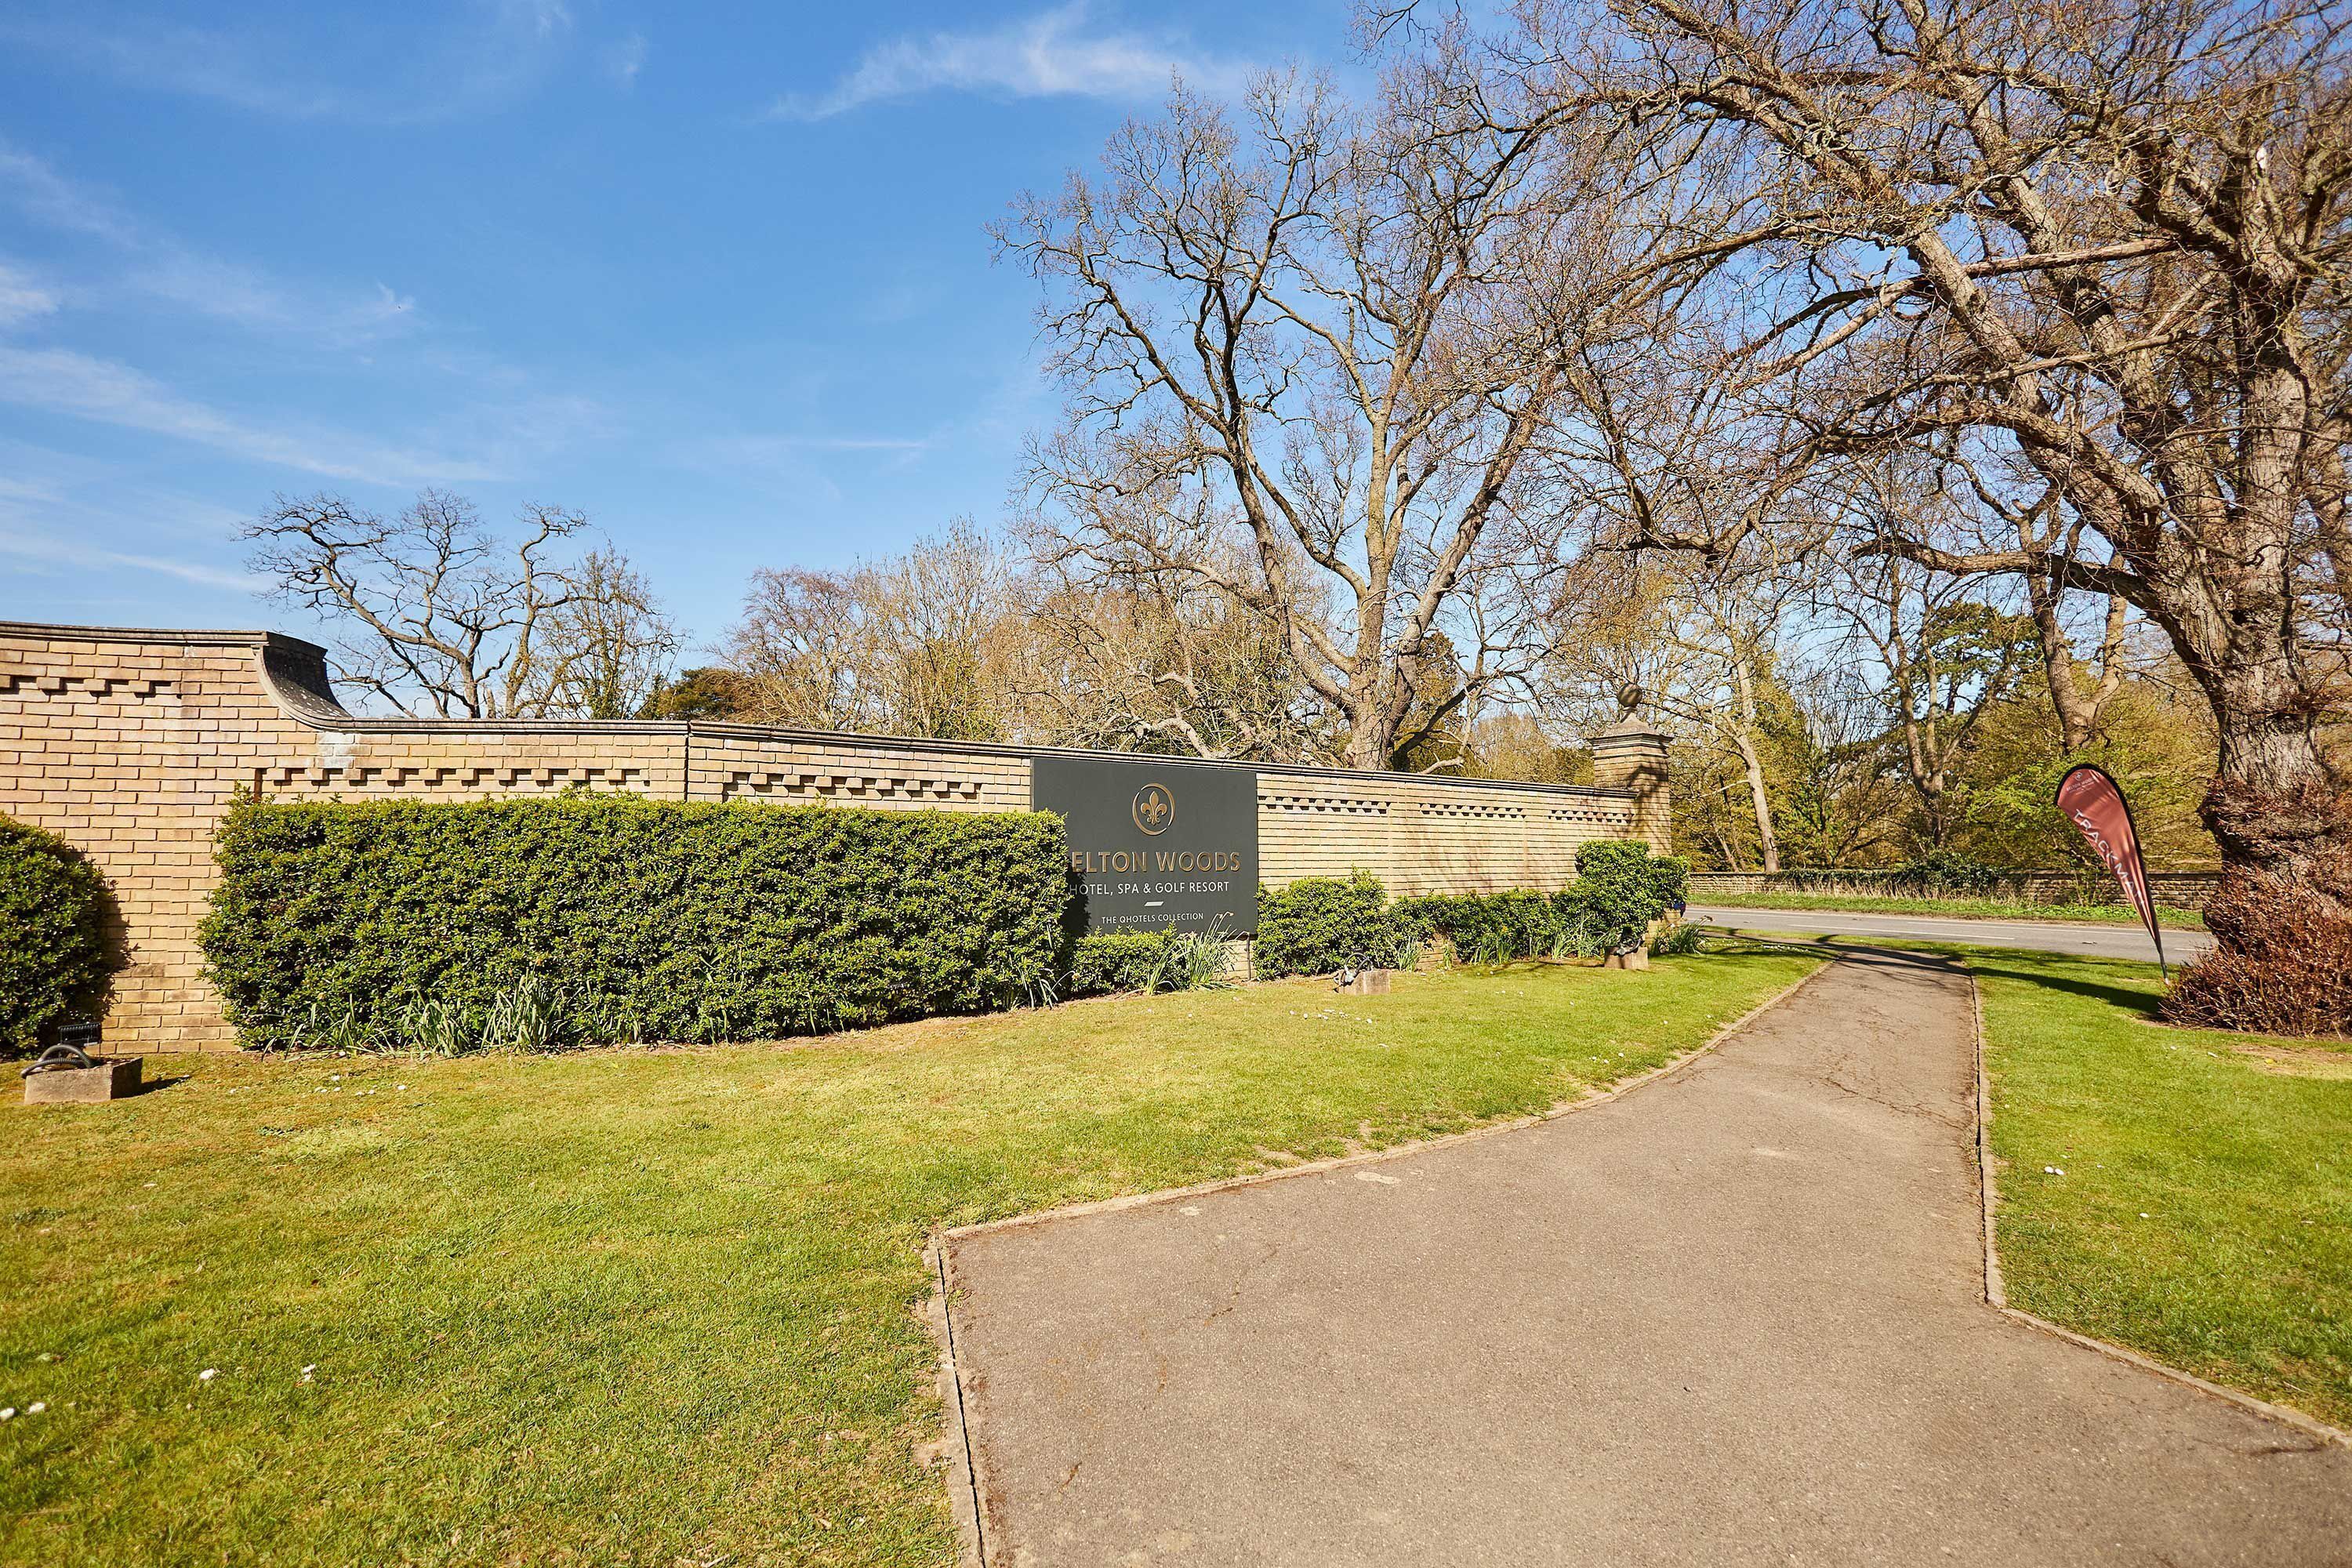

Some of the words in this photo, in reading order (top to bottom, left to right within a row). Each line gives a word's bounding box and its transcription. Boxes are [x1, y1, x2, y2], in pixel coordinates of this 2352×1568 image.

[1066, 851, 1148, 873] ELTON
[1156, 851, 1241, 872] WOODS
[1069, 884, 1113, 896] HOTEL,
[1118, 883, 1139, 894] SPA
[1143, 883, 1151, 894] &
[1155, 882, 1185, 893] GOLF
[1189, 881, 1229, 892] RESORT
[1102, 916, 1116, 924] THE
[1119, 914, 1156, 924] QHOTELS
[1157, 913, 1203, 922] COLLECTION
